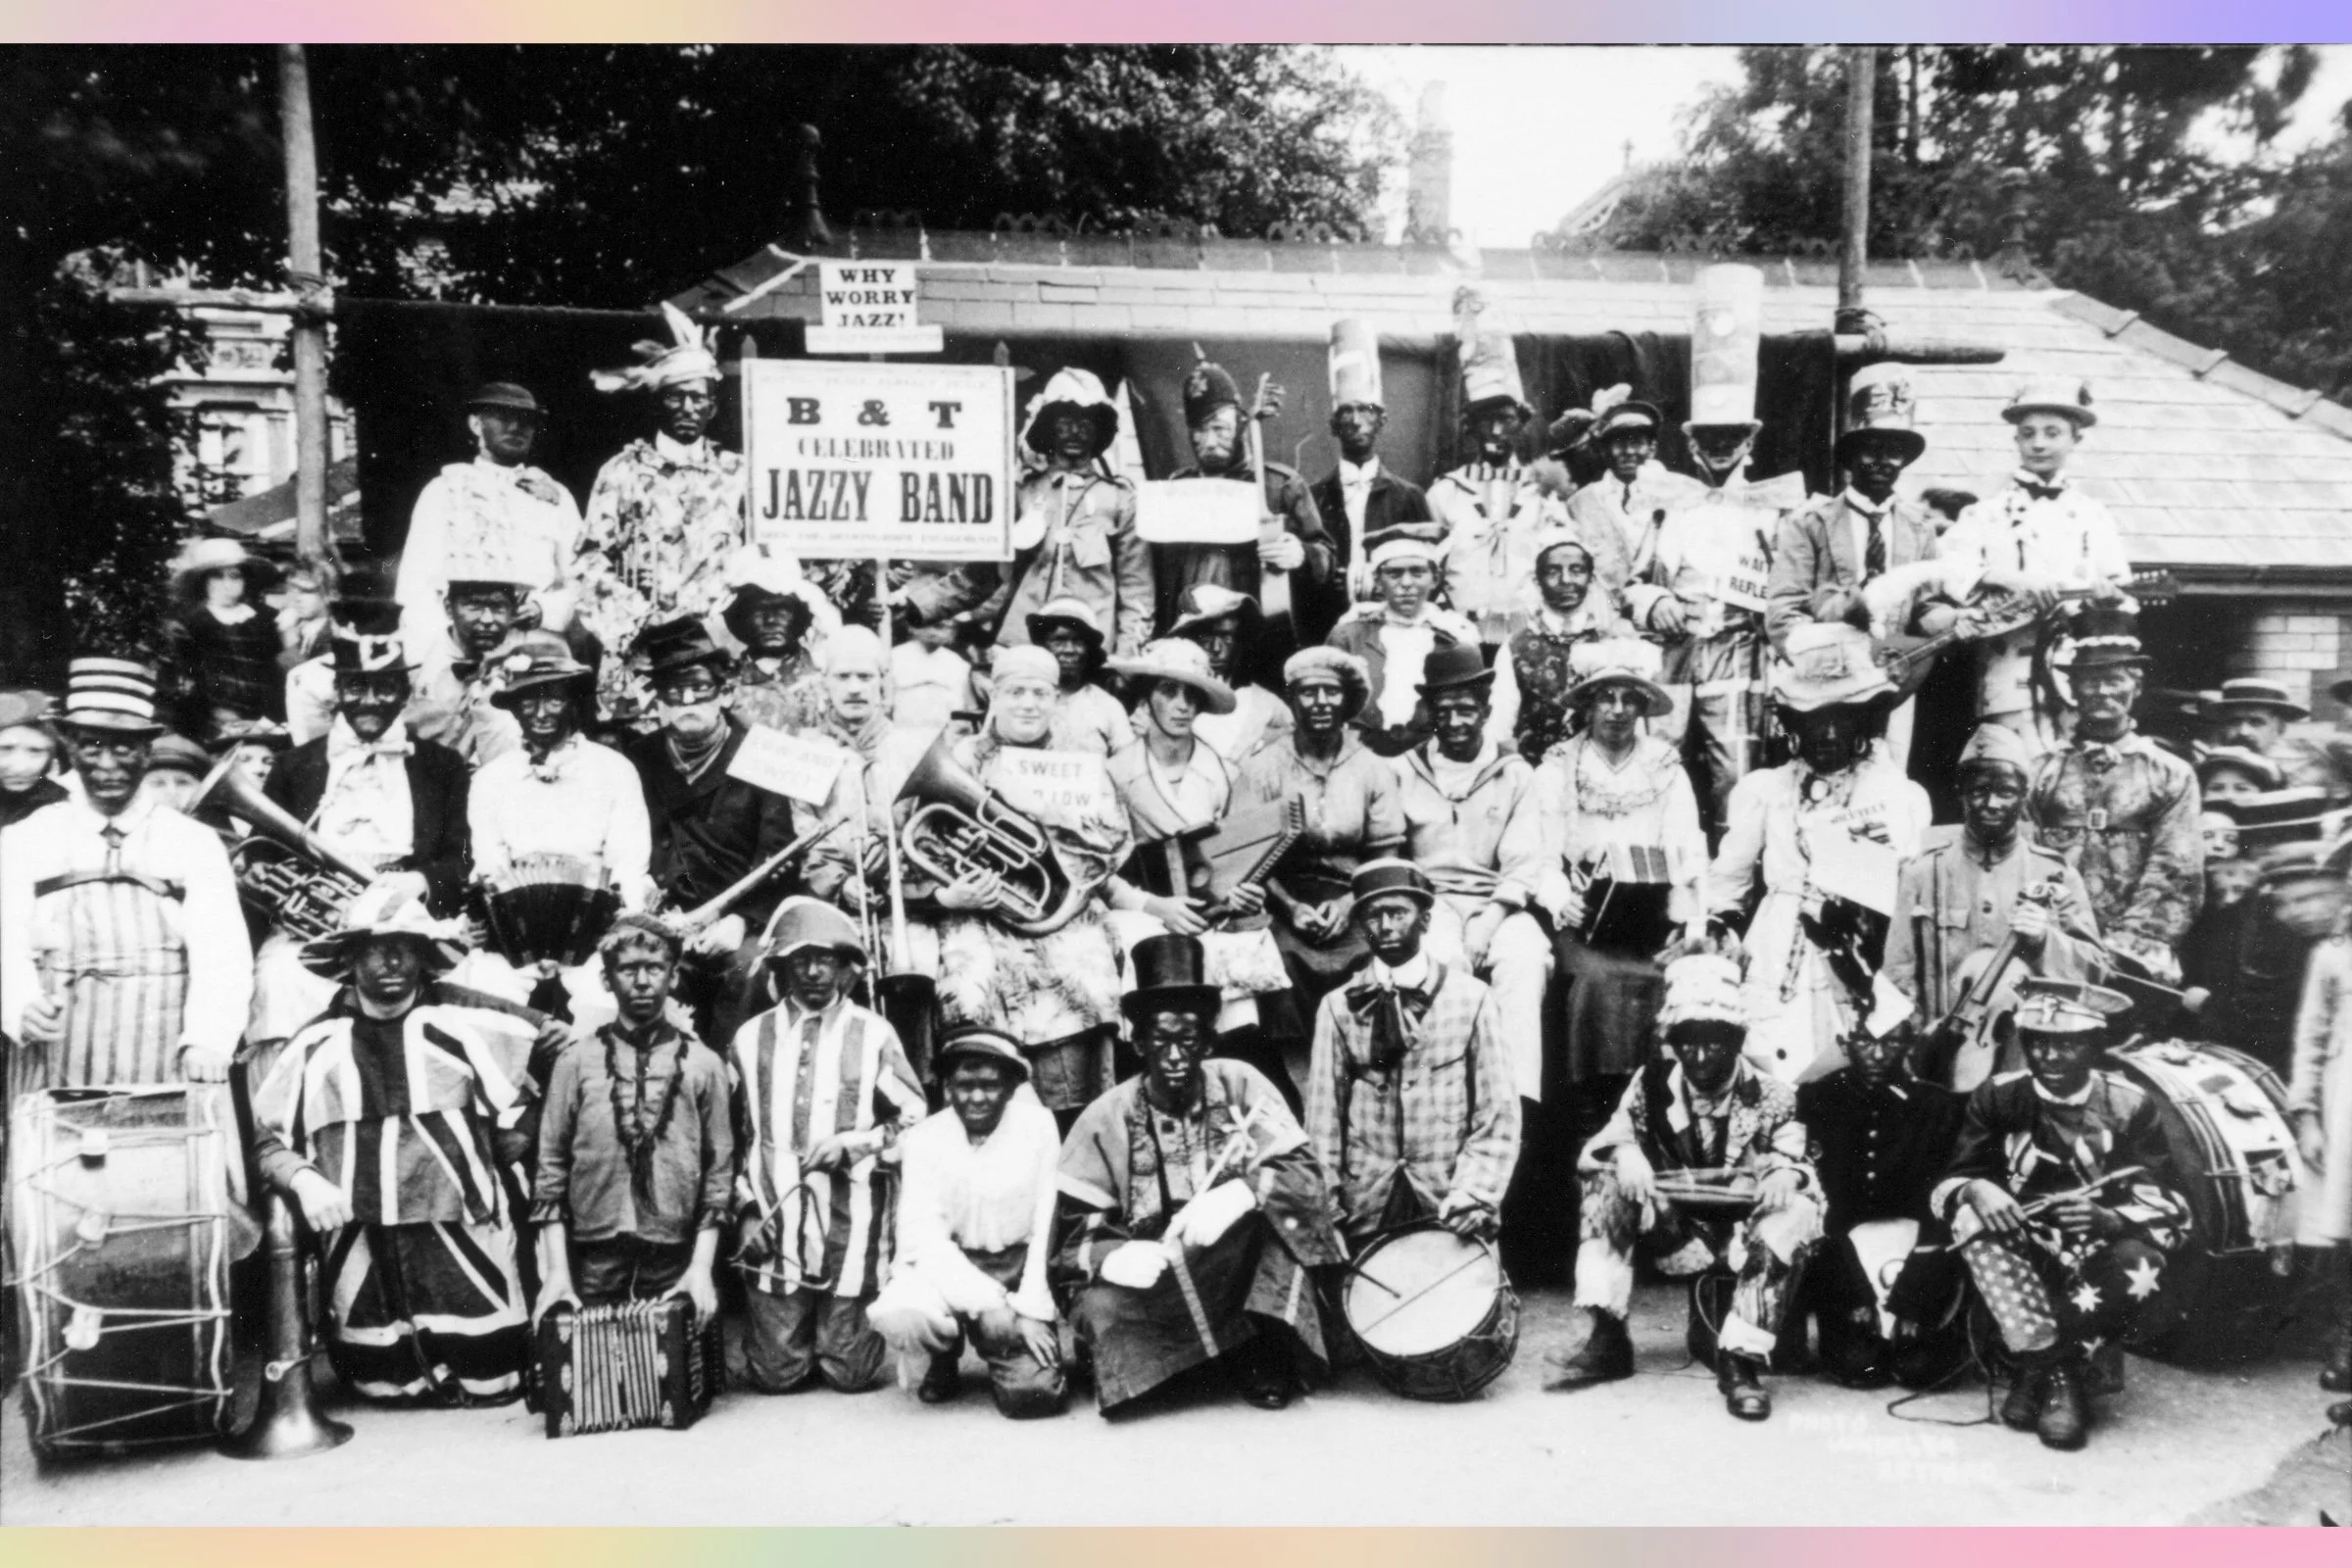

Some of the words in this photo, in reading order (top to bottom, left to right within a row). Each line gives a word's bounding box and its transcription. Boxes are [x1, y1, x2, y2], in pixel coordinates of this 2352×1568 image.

[839, 269, 897, 283] WHY
[826, 290, 914, 305] WORRY
[837, 314, 906, 327] JAZZ!
[787, 397, 821, 425] B
[858, 399, 890, 426] &
[928, 401, 962, 428] T
[798, 437, 955, 461] CELEBRATED
[762, 468, 872, 521] JAZZY
[899, 471, 993, 523] BAND
[1019, 759, 1082, 778] SWEET
